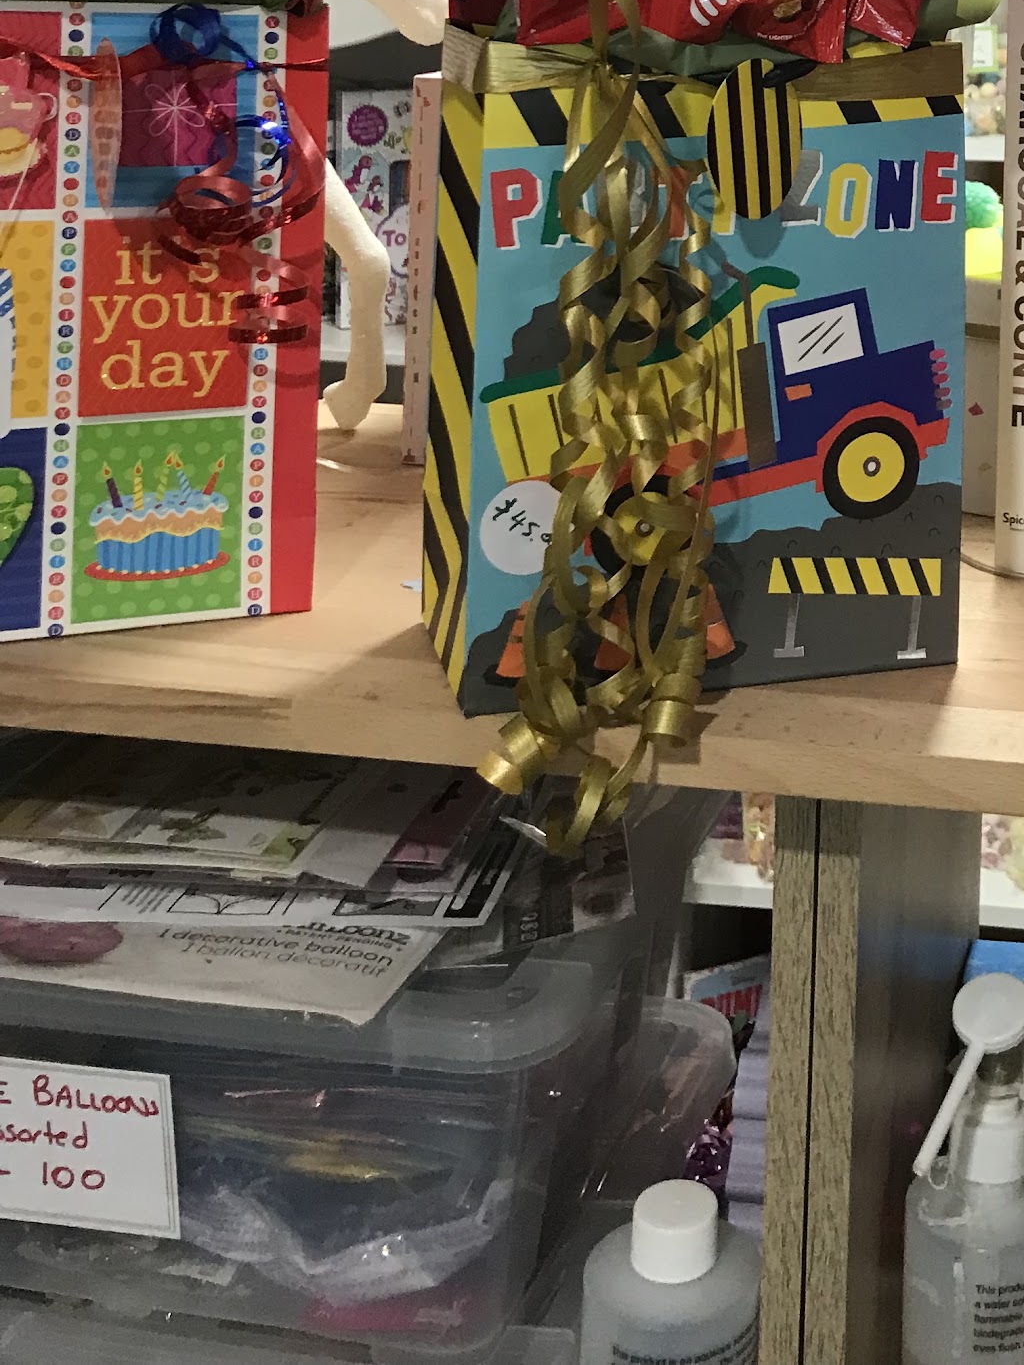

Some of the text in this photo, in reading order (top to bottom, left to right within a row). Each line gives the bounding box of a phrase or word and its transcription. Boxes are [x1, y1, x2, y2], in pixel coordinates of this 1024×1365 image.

[89, 286, 250, 344] your
[100, 339, 231, 399] day
[172, 928, 300, 950] decorative
[304, 941, 395, 967] balloon
[196, 941, 271, 961] ballon
[276, 949, 388, 978] decoratif
[42, 1161, 106, 1191] 100
[975, 1284, 997, 1295] This
